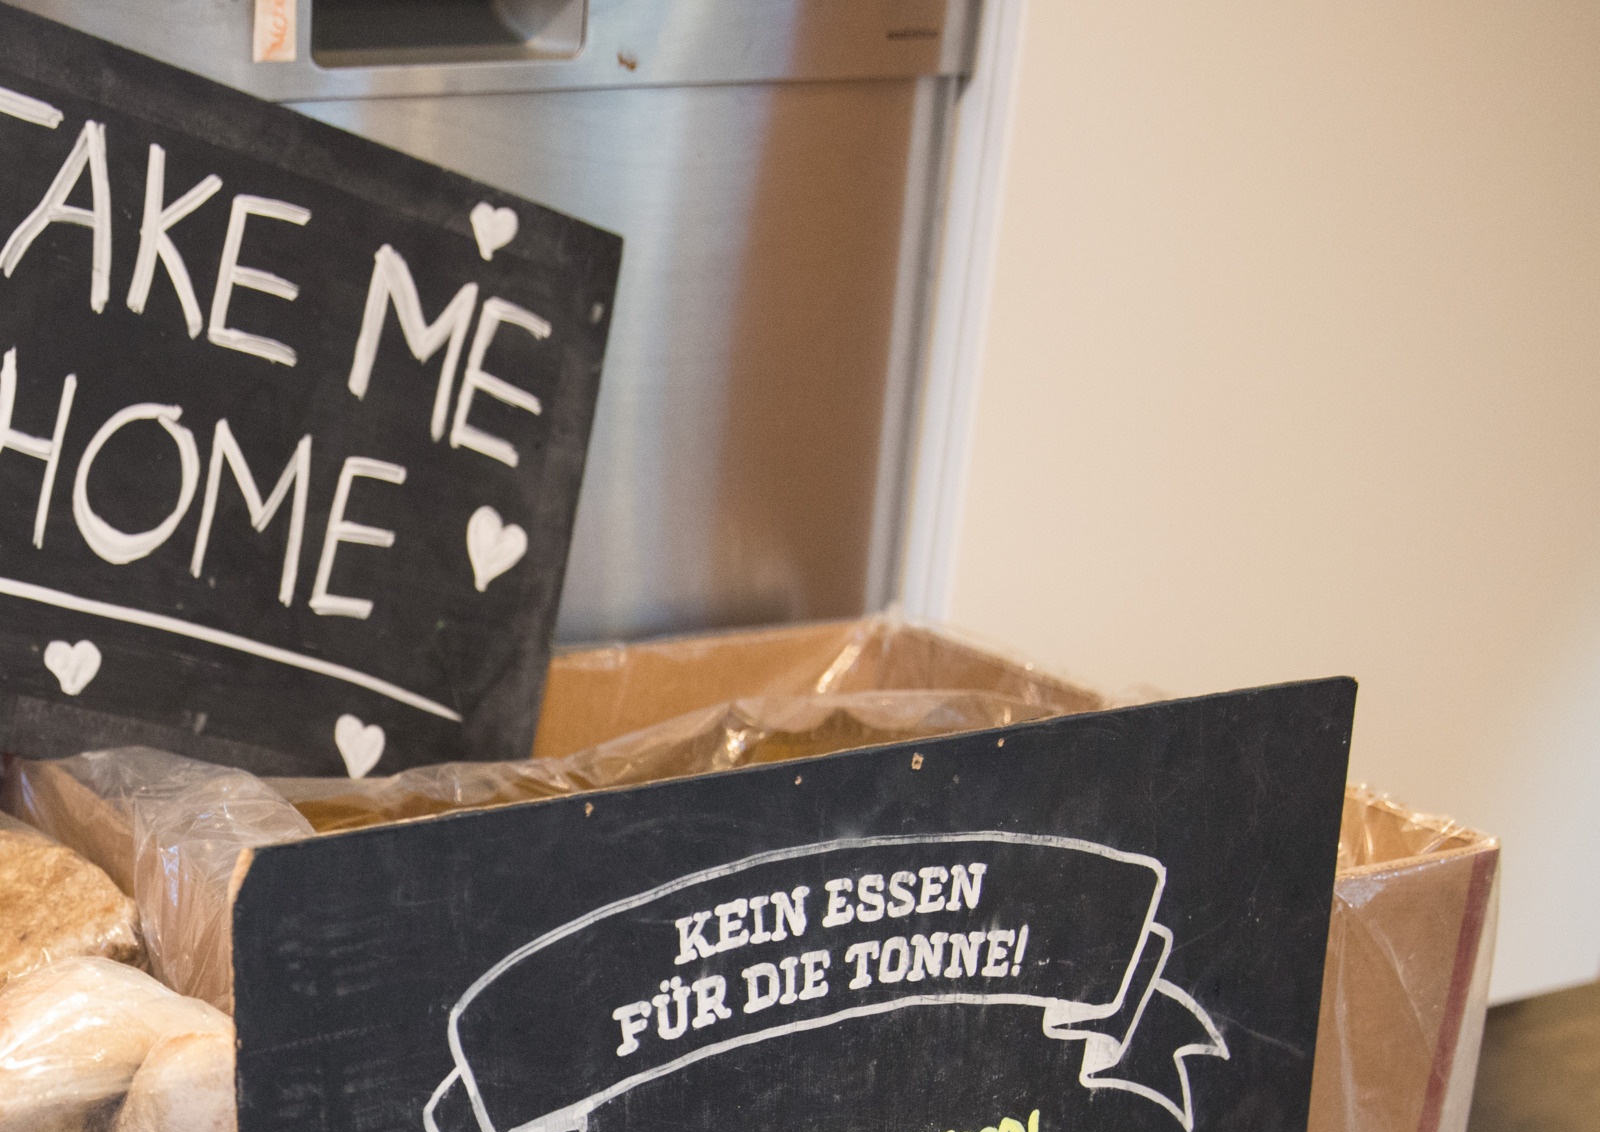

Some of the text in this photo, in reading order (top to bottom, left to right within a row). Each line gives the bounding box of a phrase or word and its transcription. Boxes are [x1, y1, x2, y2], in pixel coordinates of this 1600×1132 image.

[348, 244, 552, 468] ME
[673, 862, 988, 965] KEIN ESSEN
[612, 924, 1030, 1057] FÜR DIE TONNE!
